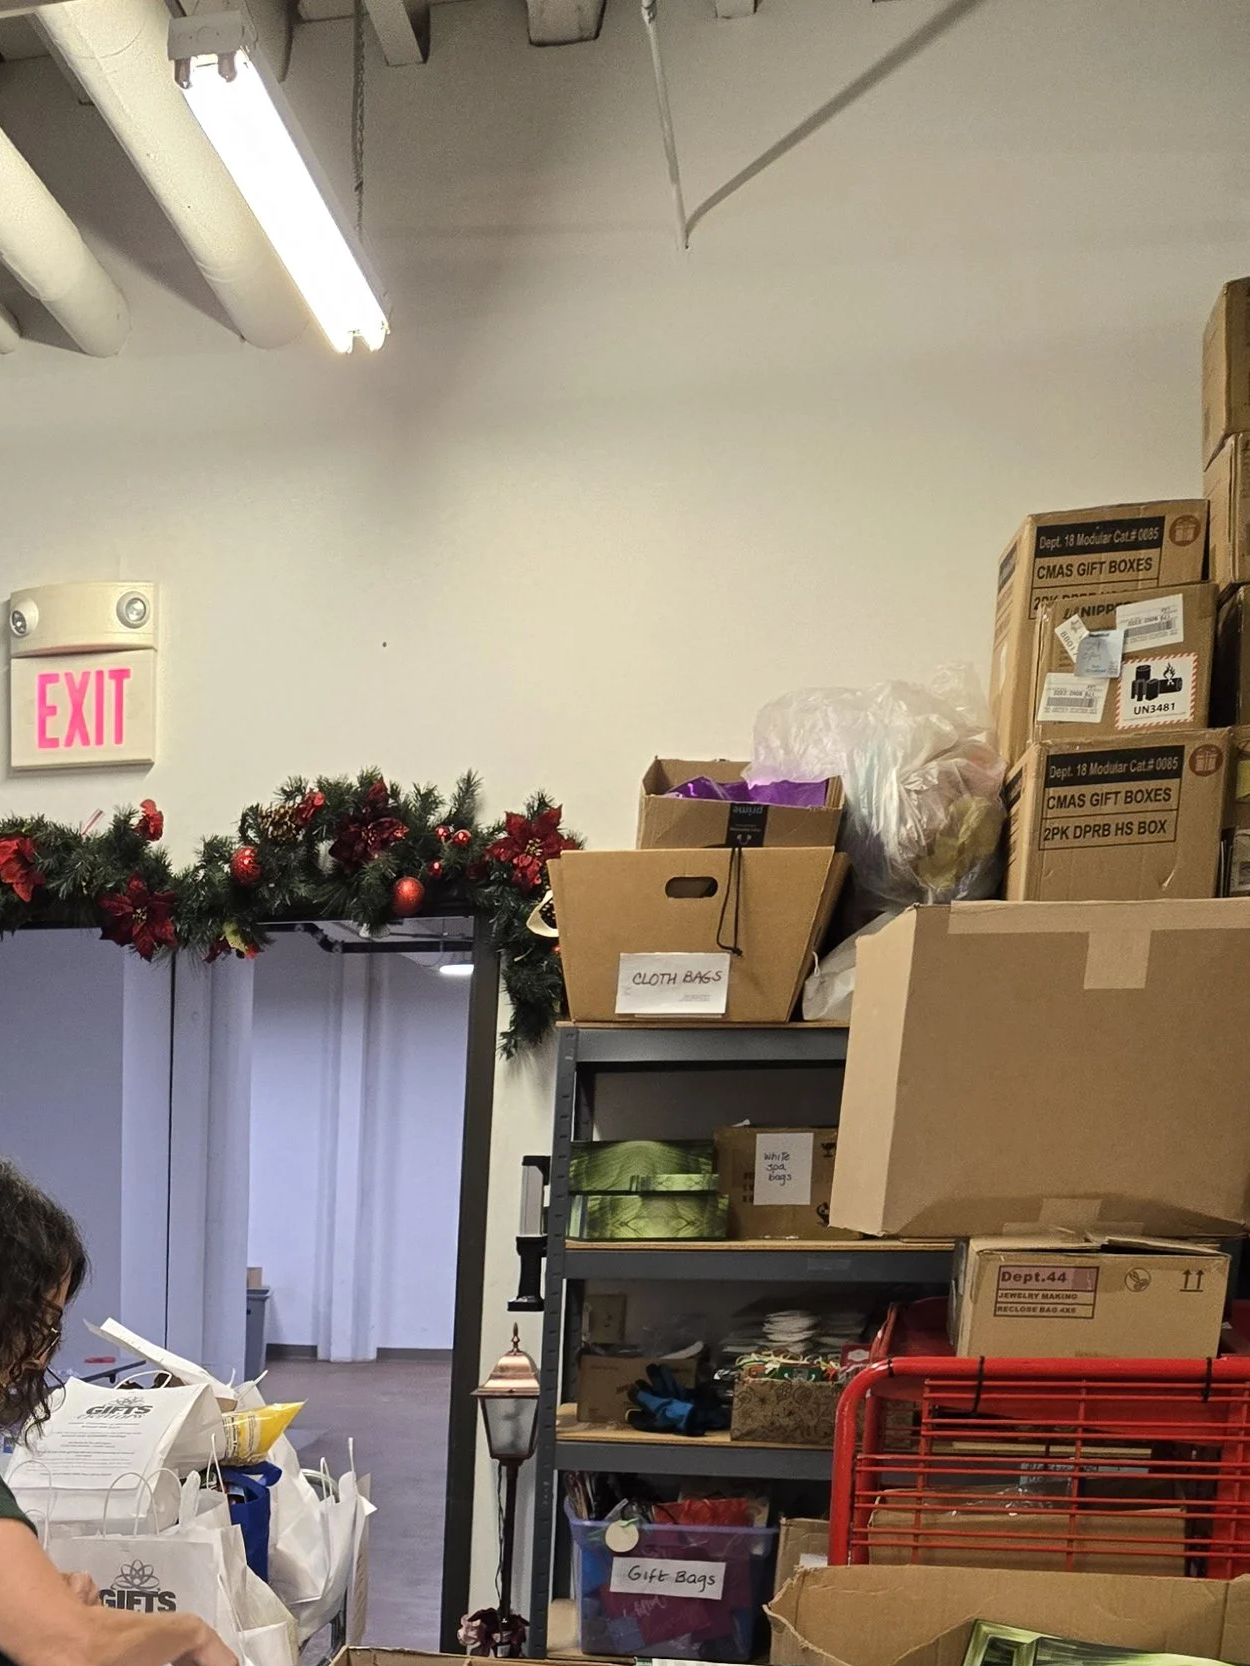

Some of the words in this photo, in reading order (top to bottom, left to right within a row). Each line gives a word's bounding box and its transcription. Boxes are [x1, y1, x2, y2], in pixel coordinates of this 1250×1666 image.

[1039, 534, 1061, 550] Dept.
[1064, 533, 1075, 545] 18
[1077, 532, 1112, 547] Modular
[1036, 563, 1073, 580] CMAS
[1076, 560, 1106, 576] GIFT
[1109, 557, 1153, 572] BOXES
[37, 668, 131, 749] EXIT
[1133, 702, 1176, 715] UN3481
[1050, 764, 1073, 780] Dept.
[1076, 764, 1087, 776] 18
[1089, 762, 1128, 777] Modular
[1156, 757, 1178, 771] 0085
[1046, 793, 1086, 810] CMAS
[1090, 791, 1121, 807] GIFT
[1125, 787, 1172, 804] BOXES
[1043, 825, 1070, 842] 2PK
[1073, 822, 1111, 839] DPRB
[1115, 821, 1133, 837] HS
[1138, 819, 1167, 835] BOX
[632, 972, 677, 986] CLOTH
[682, 970, 723, 984] BAGS
[766, 1164, 787, 1173] spa
[768, 1174, 792, 1186] bags
[1001, 1271, 1067, 1284] Dept.44
[998, 1292, 1040, 1300] JEWELRY
[1042, 1292, 1078, 1300] MAKING
[997, 1305, 1037, 1314] RECLOSE
[85, 1405, 154, 1416] GIFTS
[627, 1565, 670, 1584] Gift
[674, 1570, 717, 1593] Bags
[99, 1589, 176, 1613] GIFTS
